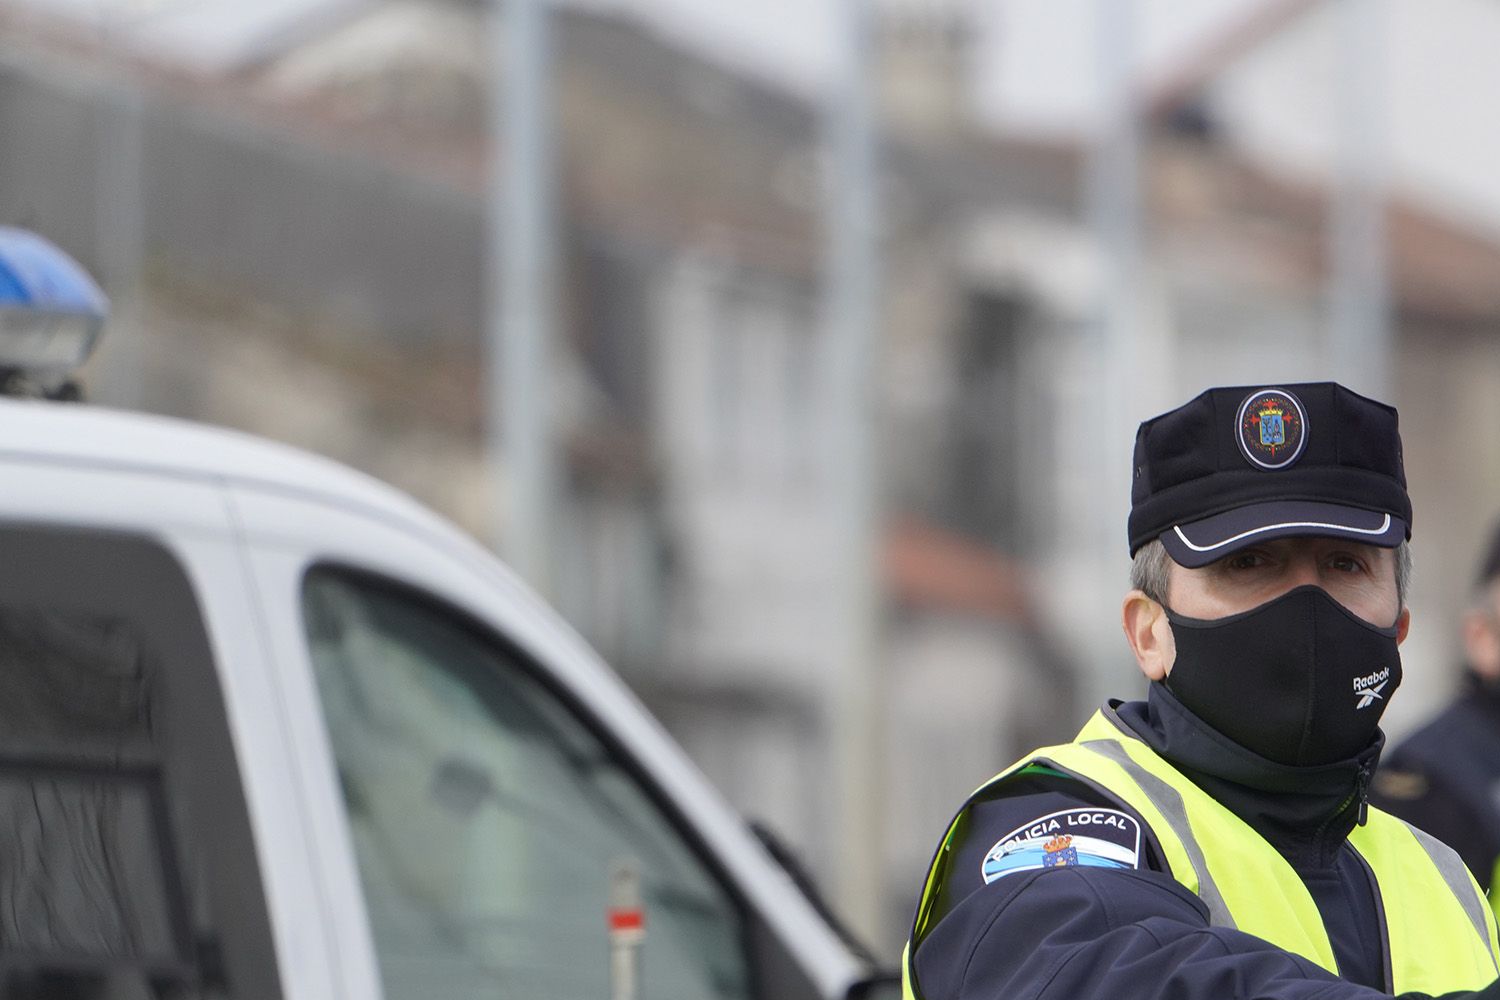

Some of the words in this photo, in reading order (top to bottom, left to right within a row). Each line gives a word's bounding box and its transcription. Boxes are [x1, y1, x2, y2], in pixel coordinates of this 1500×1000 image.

[1353, 666, 1390, 691] Reebok
[992, 819, 1061, 862] POLICIA
[1067, 813, 1127, 830] LOCAL
